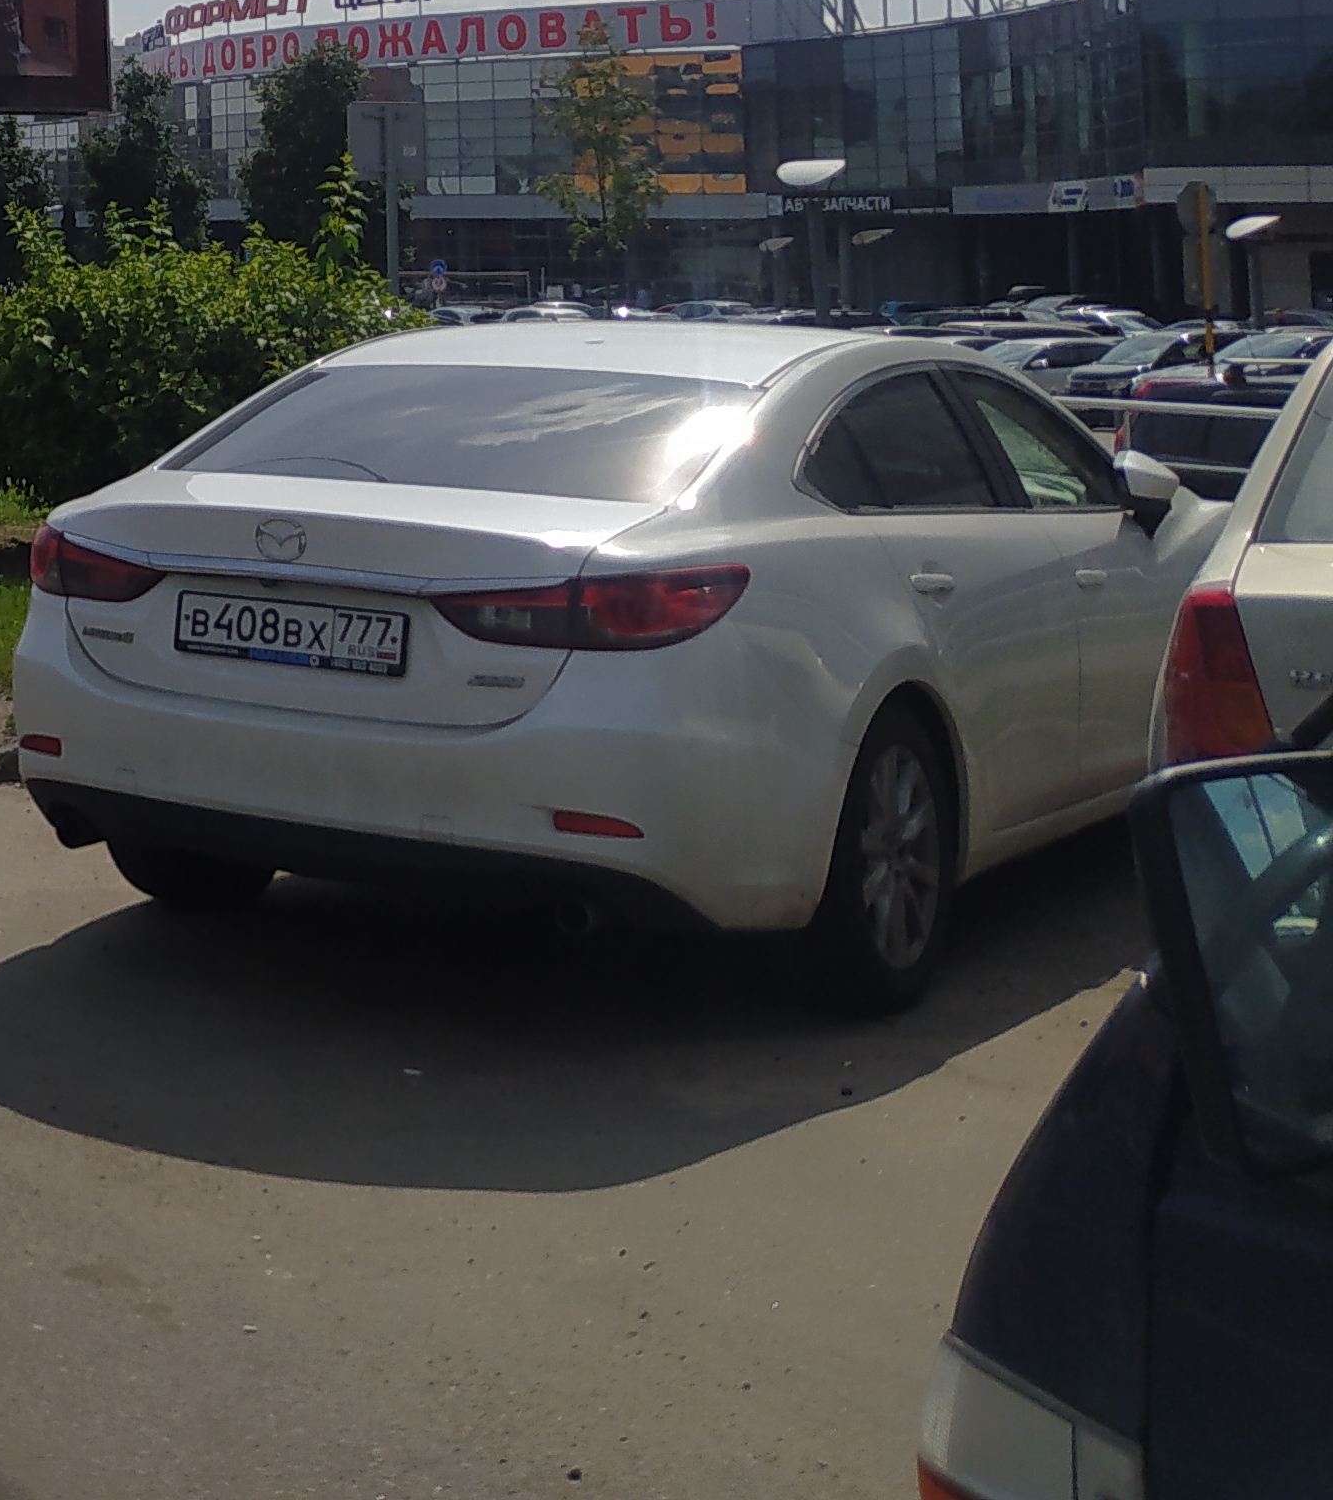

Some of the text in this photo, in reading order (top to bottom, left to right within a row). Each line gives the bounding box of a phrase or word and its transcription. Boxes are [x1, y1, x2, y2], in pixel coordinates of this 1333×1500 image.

[202, 31, 300, 77] ДОБРО
[317, 2, 717, 63] ПОЖАЛОВАТЬ!
[783, 196, 891, 213] АВЗАПЧАСТИ
[190, 602, 393, 652] В408ВХ 777
